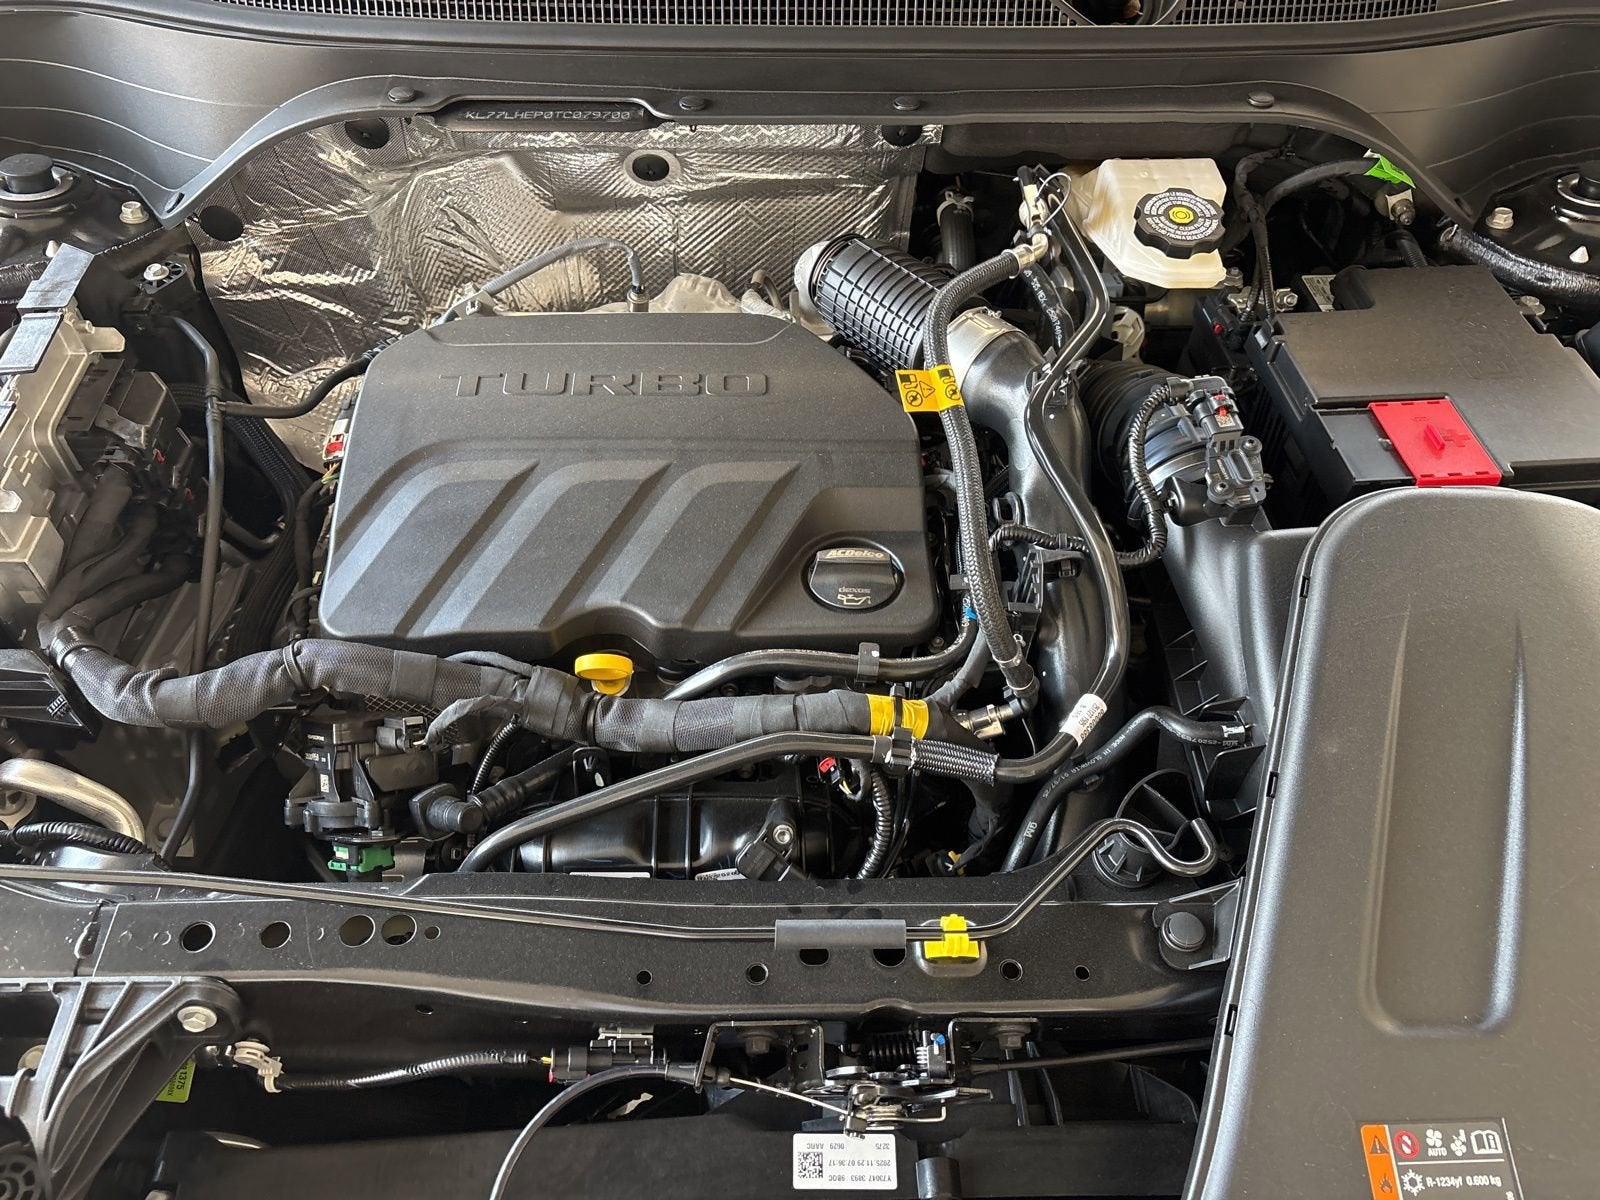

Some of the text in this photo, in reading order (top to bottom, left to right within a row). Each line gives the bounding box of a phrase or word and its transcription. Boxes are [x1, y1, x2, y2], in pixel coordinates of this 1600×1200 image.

[438, 372, 768, 397] TURBO
[825, 550, 884, 559] ACDelco
[838, 586, 871, 594] dexos
[176, 1071, 187, 1090] 1375
[1427, 1147, 1448, 1157] AUTO
[1425, 1175, 1463, 1189] R-1234yf
[1489, 1175, 1502, 1188] kg
